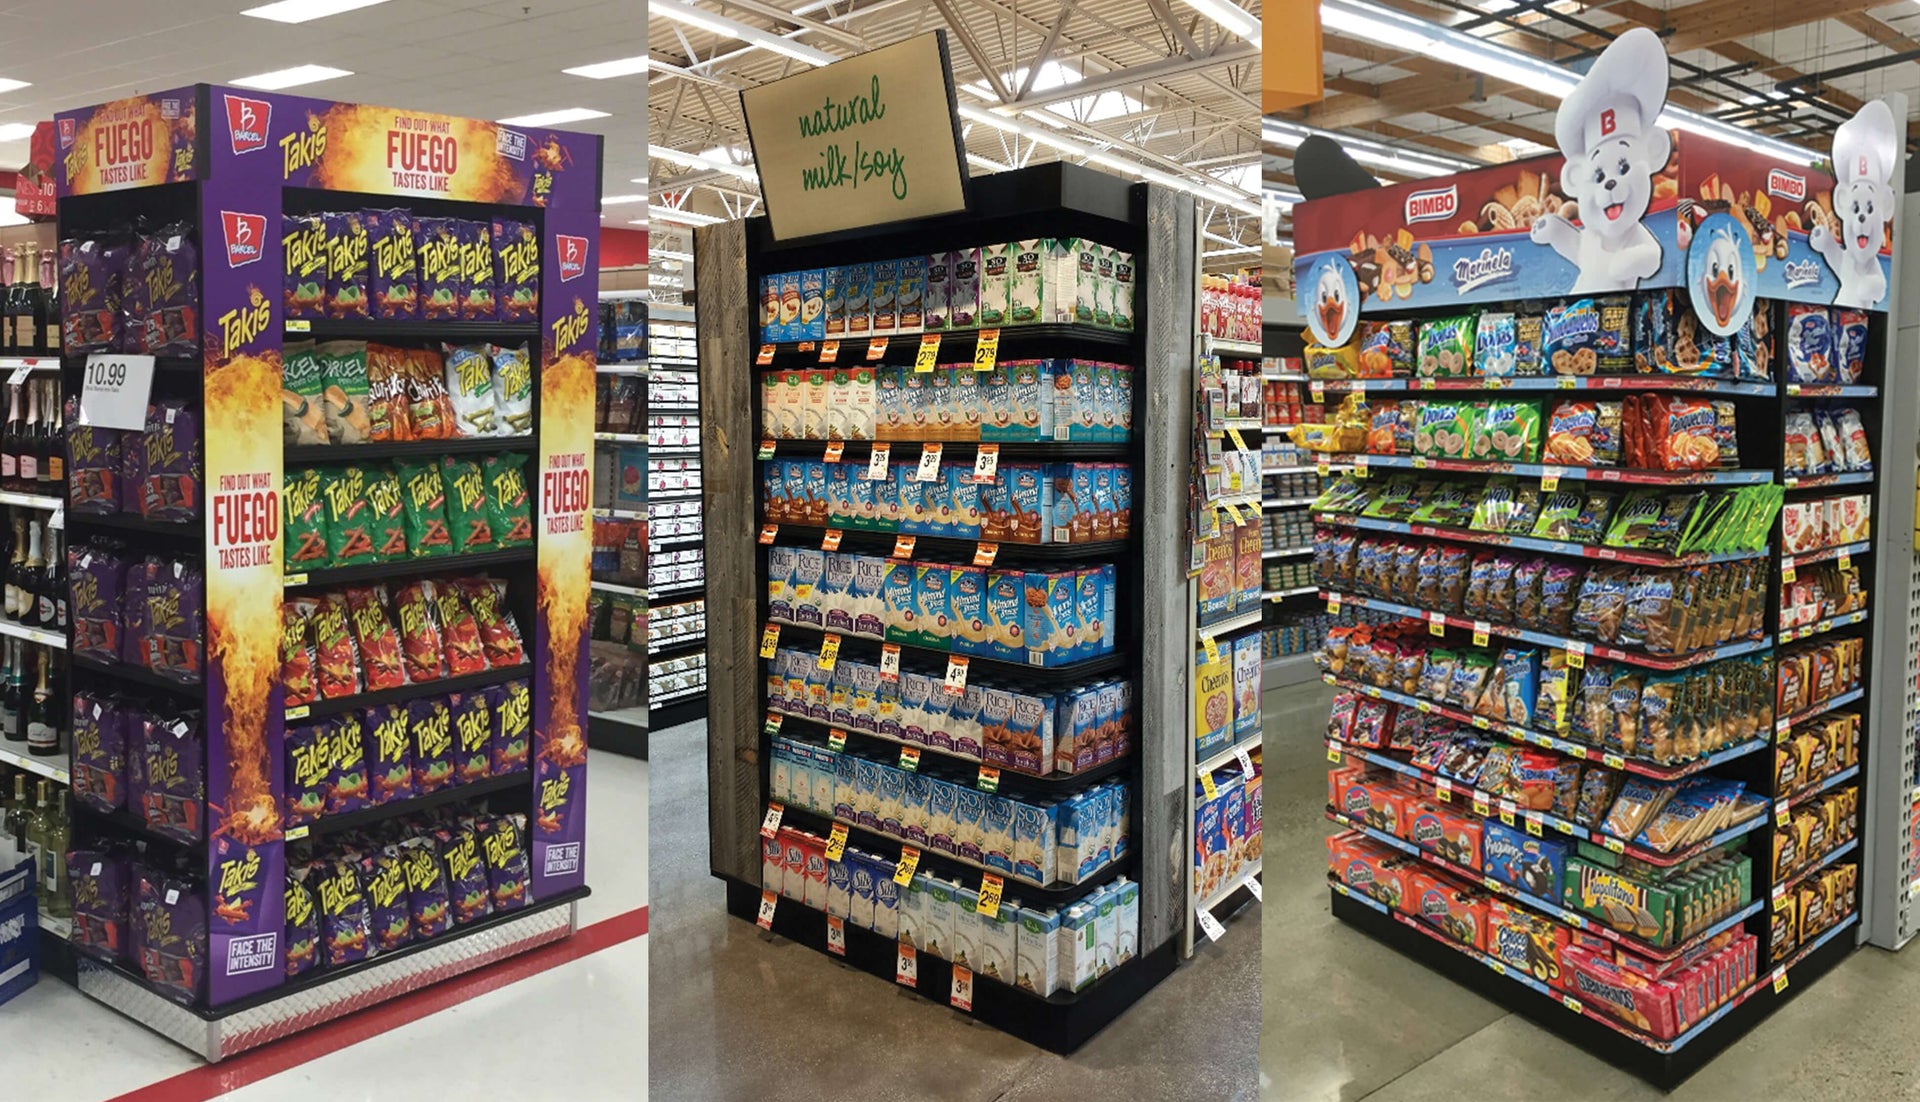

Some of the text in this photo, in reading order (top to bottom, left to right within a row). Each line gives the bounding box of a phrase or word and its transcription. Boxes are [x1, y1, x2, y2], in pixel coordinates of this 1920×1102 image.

[129, 105, 147, 120] WHAT
[799, 74, 886, 138] natural
[395, 116, 450, 133] FIND OUT WHAT
[1600, 108, 1617, 136] B
[95, 119, 153, 167] FUEGO
[234, 130, 262, 142] BARCEL
[499, 131, 525, 149] FACE THE
[279, 122, 327, 180] Takis
[387, 130, 457, 175] FUEGO
[63, 143, 88, 185] Takis
[803, 141, 908, 201] milk/soy
[1858, 155, 1868, 176] B
[100, 165, 127, 185] TASTES
[392, 172, 427, 190] TASTES
[1770, 174, 1805, 196] BIMBO
[1409, 193, 1455, 217] BIMBO
[230, 244, 257, 255] BARCEL
[282, 222, 326, 275] Takis
[326, 229, 369, 280] Takis
[373, 227, 414, 278] Takis
[418, 236, 459, 282] Takis
[500, 234, 538, 284] Takis
[1456, 246, 1512, 281] Marinela
[1785, 259, 1820, 282] Marinela
[146, 260, 173, 306] Takis
[218, 294, 270, 359] Takis
[552, 306, 589, 358] Takis
[976, 348, 995, 364] 279
[88, 362, 126, 387] 10.99
[283, 356, 319, 381] RCEL
[1670, 409, 1715, 435] Panquecitos
[548, 453, 585, 469] FIND OUT WHAT
[220, 473, 271, 490] FIND OUT WHAT
[544, 469, 589, 515] FUEGO
[283, 473, 320, 525] Takis
[325, 470, 363, 523] Takis
[1483, 484, 1514, 505] Nito
[1546, 490, 1580, 513] Nito
[1626, 497, 1661, 517] Nito
[213, 491, 278, 546] FUEGO
[547, 515, 569, 535] TASTES
[219, 547, 250, 570] TASTES
[771, 552, 792, 565] RICE
[798, 553, 821, 569] RICE
[828, 556, 851, 572] RICE
[857, 560, 882, 577] RICE
[991, 596, 1019, 613] Almond
[311, 604, 342, 648] Takis
[353, 600, 382, 642] Takis
[906, 677, 928, 692] RICE
[987, 692, 1010, 708] RICE
[1014, 698, 1041, 716] RICE
[497, 688, 529, 737] Takis
[374, 708, 408, 762] Takis
[412, 708, 449, 758] Takis
[292, 735, 328, 784] Takis
[859, 763, 880, 777] SOY
[882, 769, 903, 783] SOY
[906, 774, 930, 789] SOY
[540, 775, 570, 807] Takis
[934, 781, 957, 802] SOY
[960, 791, 983, 808] SOY
[987, 800, 1012, 817] SOY
[1348, 792, 1371, 812] Gansito
[1018, 807, 1043, 823] SOY
[1415, 822, 1443, 843] Gansito
[483, 827, 514, 868] Takis
[547, 845, 578, 860] FACE THE
[444, 837, 475, 881] Takis
[546, 859, 577, 872] INTENSITY
[807, 856, 824, 871] Silk
[219, 853, 261, 894] Takis
[368, 859, 401, 909] Takis
[853, 871, 873, 889] Silk
[1350, 868, 1373, 885] Gansito
[318, 868, 355, 915] Takis
[979, 890, 1000, 908] 269
[1590, 880, 1635, 906] Napolitano
[1423, 897, 1449, 917] Gansito
[231, 937, 273, 957] FACE THE
[1498, 926, 1527, 947] Choco
[230, 953, 272, 970] INTENSITY
[1502, 944, 1527, 961] Roles
[1575, 968, 1635, 1012] SUBMARINOS
